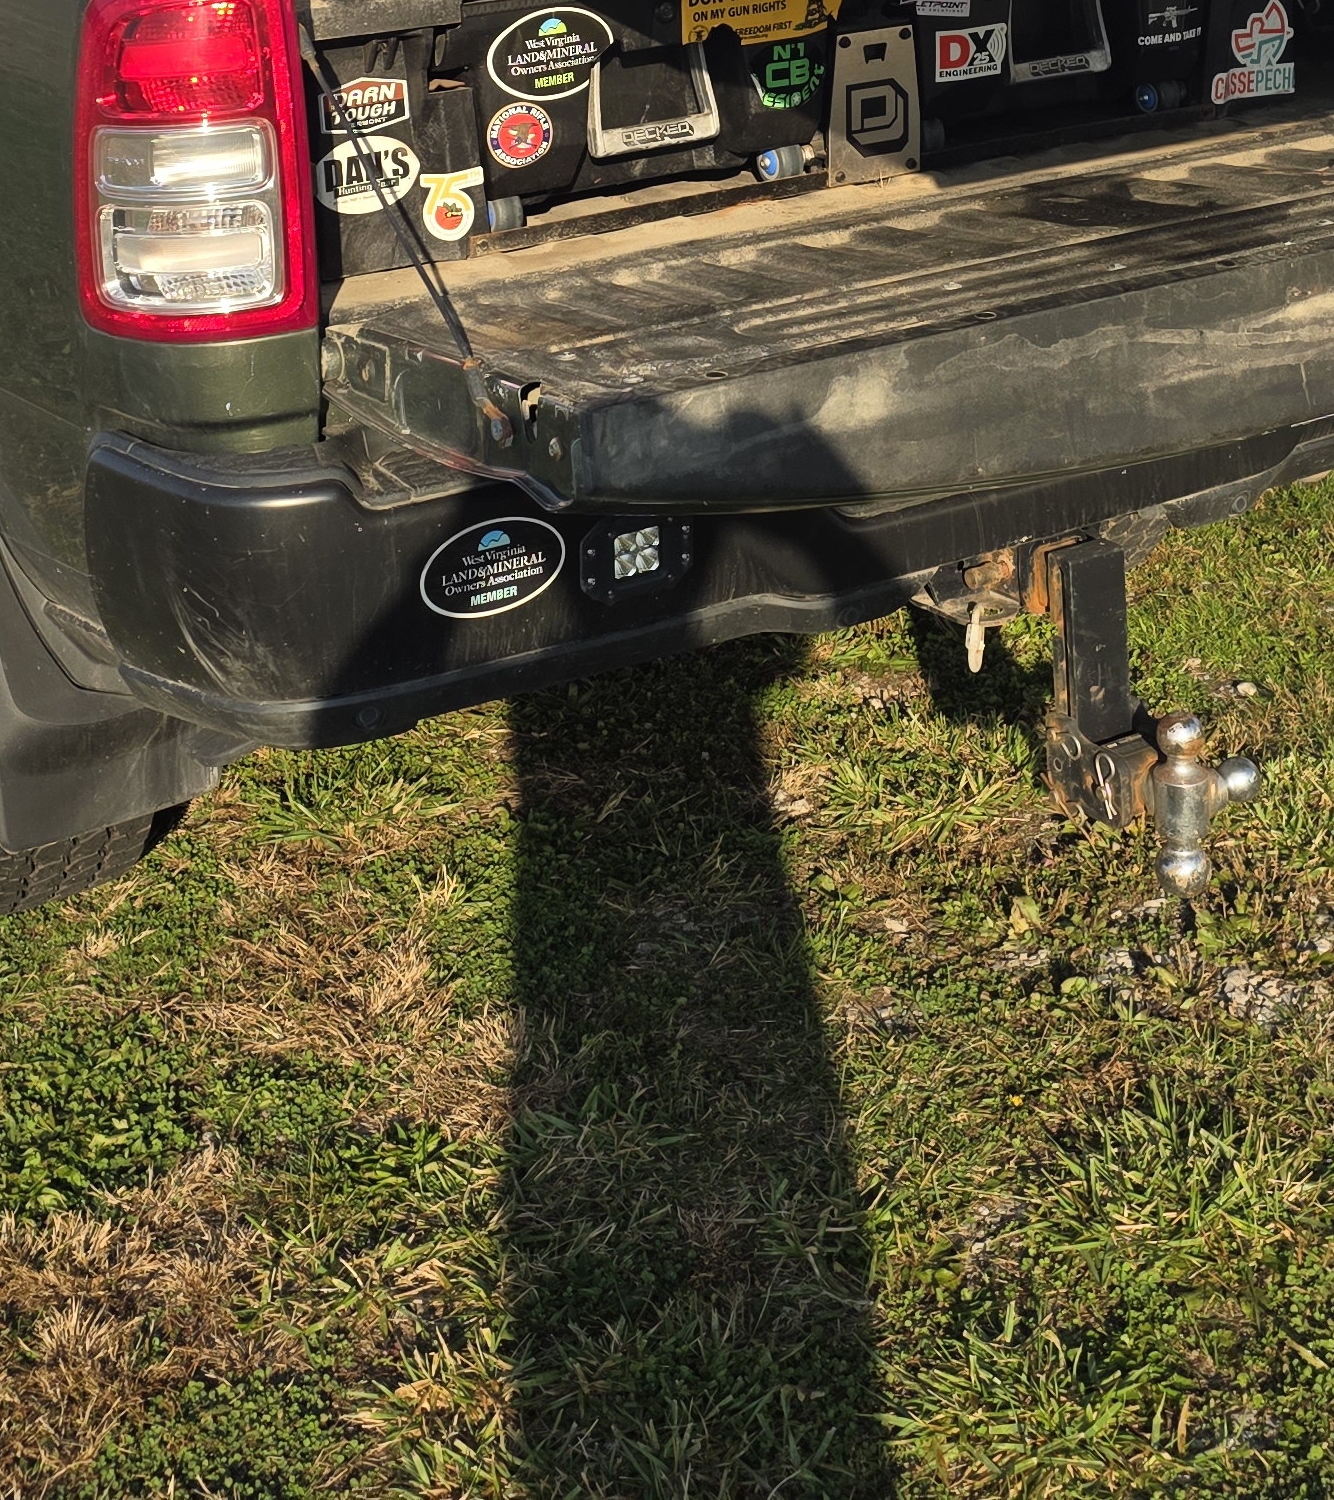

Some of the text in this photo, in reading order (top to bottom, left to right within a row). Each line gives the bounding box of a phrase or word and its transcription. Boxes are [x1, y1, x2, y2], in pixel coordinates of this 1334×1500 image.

[693, 0, 787, 23] ON MY GUN RIGHTS
[525, 32, 581, 50] West Virginia
[939, 28, 996, 70] DX
[1137, 34, 1163, 46] COME
[1163, 32, 1182, 43] AND
[510, 55, 595, 77] Owners Association
[973, 51, 990, 66] 25
[534, 71, 575, 89] MEMBER
[765, 57, 810, 89] CB
[939, 63, 998, 78] ENGINEERING
[489, 105, 550, 139] NATIONAL RIFLE
[622, 120, 694, 146] DECKED
[494, 141, 549, 166] ASSOCIATION
[337, 184, 373, 196] Hunting
[461, 544, 526, 568] West Virginia
[444, 564, 544, 597] Owners Association
[470, 585, 518, 607] MEMBER
